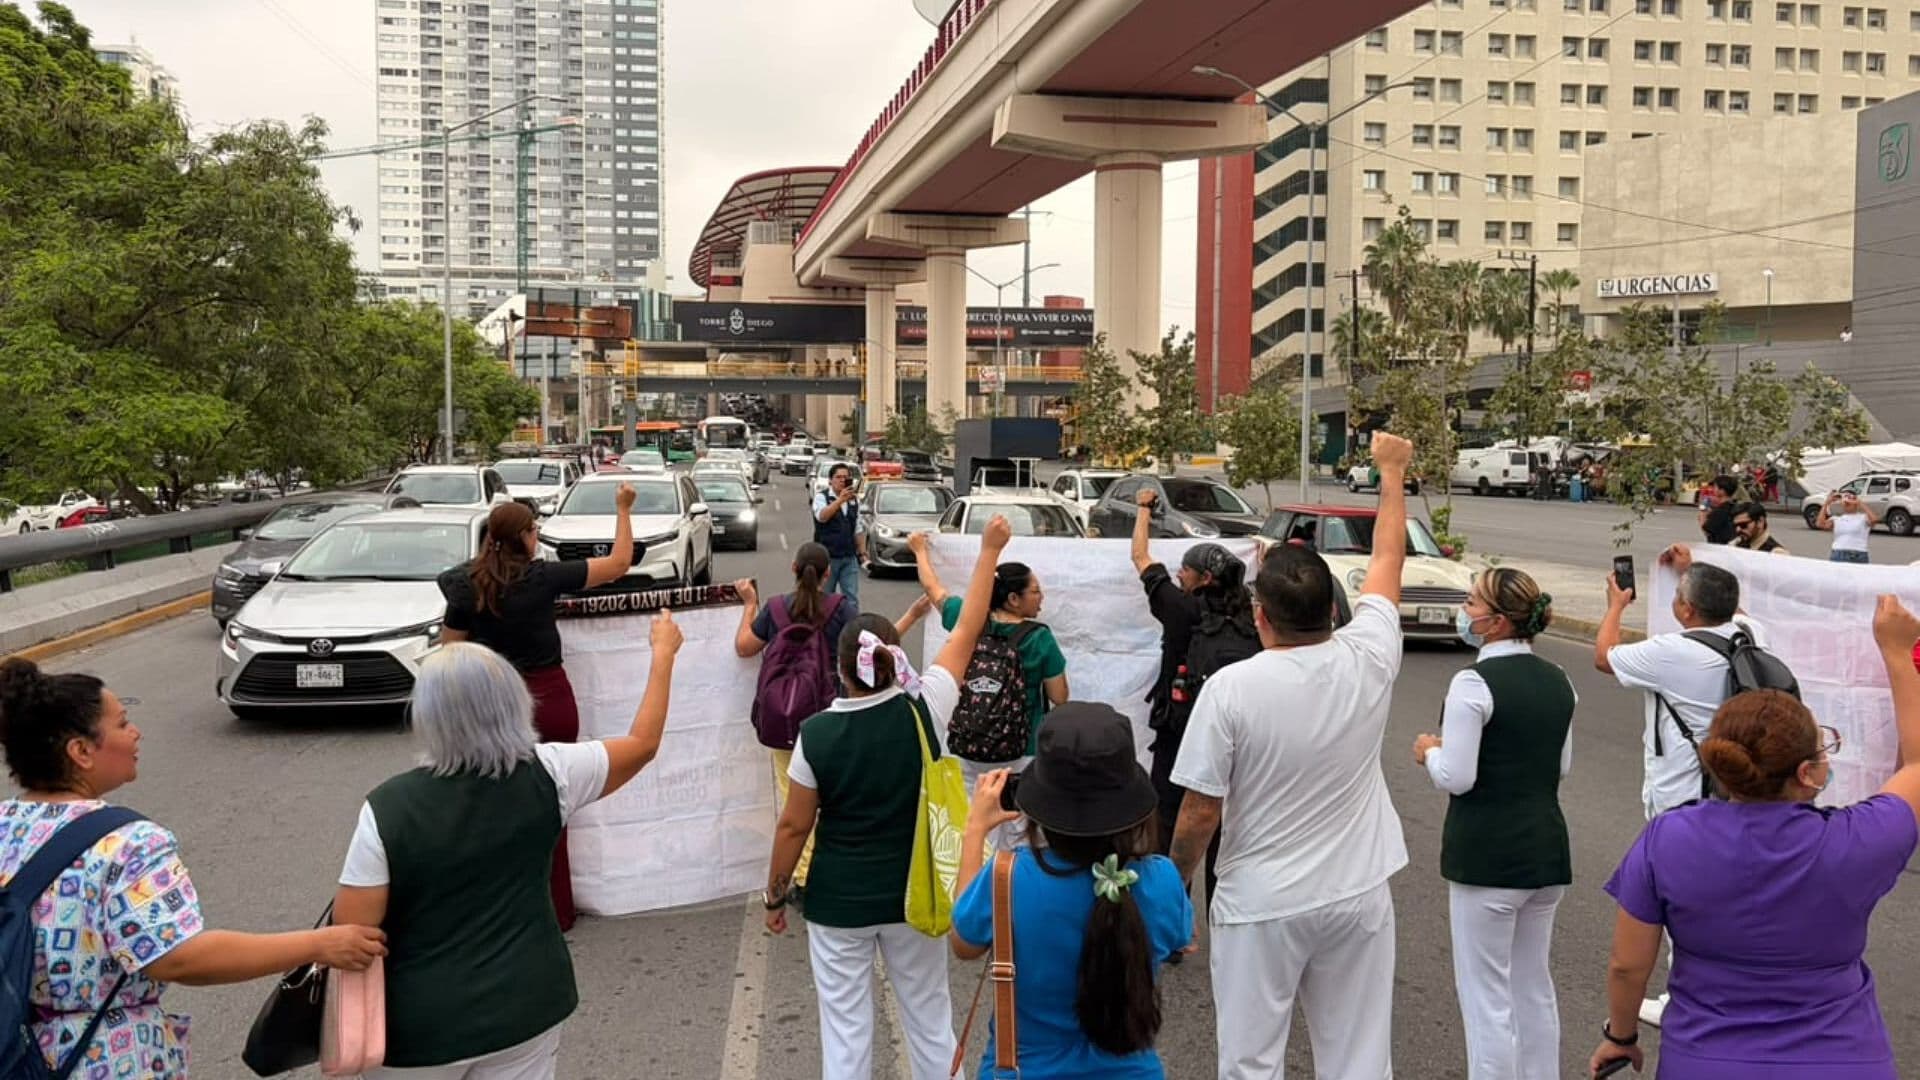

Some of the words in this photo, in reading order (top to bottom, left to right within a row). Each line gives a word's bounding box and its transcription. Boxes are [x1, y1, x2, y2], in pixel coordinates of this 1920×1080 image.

[1617, 274, 1711, 294] URGENCIAS
[699, 318, 725, 326] TORRE
[746, 319, 775, 327] DIEGO
[967, 312, 1002, 322] RECTO
[1004, 313, 1030, 322] PARA
[1032, 313, 1059, 322] VIVIR
[1061, 313, 1069, 322] O
[582, 593, 627, 613] 2026!
[630, 590, 671, 609] MAYO
[673, 586, 692, 605] DE
